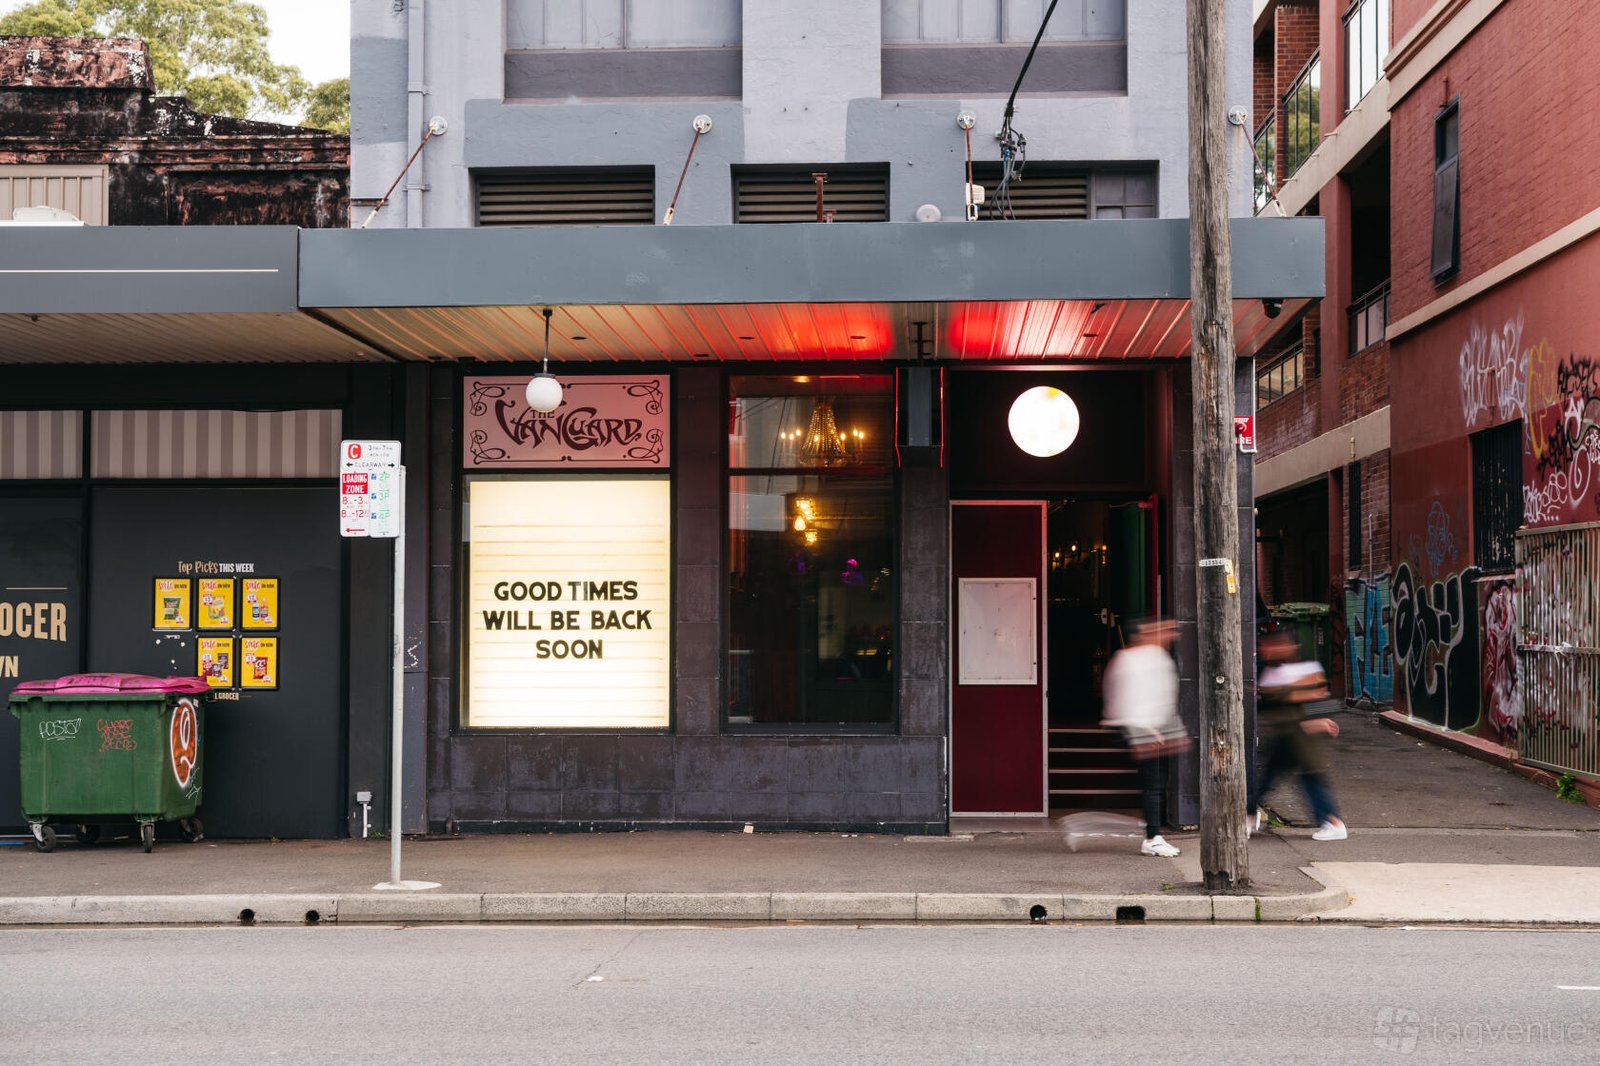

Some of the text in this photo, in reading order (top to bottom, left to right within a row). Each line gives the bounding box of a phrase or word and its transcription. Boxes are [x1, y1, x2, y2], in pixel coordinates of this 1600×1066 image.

[530, 409, 555, 419] THE
[350, 444, 360, 459] C
[342, 473, 368, 483] LOADING
[345, 485, 365, 494] ZONE
[177, 561, 254, 574] Top Picks THIS WEEK
[494, 580, 638, 601] GOOD TIMES
[0, 602, 67, 641] OCER
[483, 609, 652, 630] WILL BE BACK
[535, 639, 603, 660] SOON
